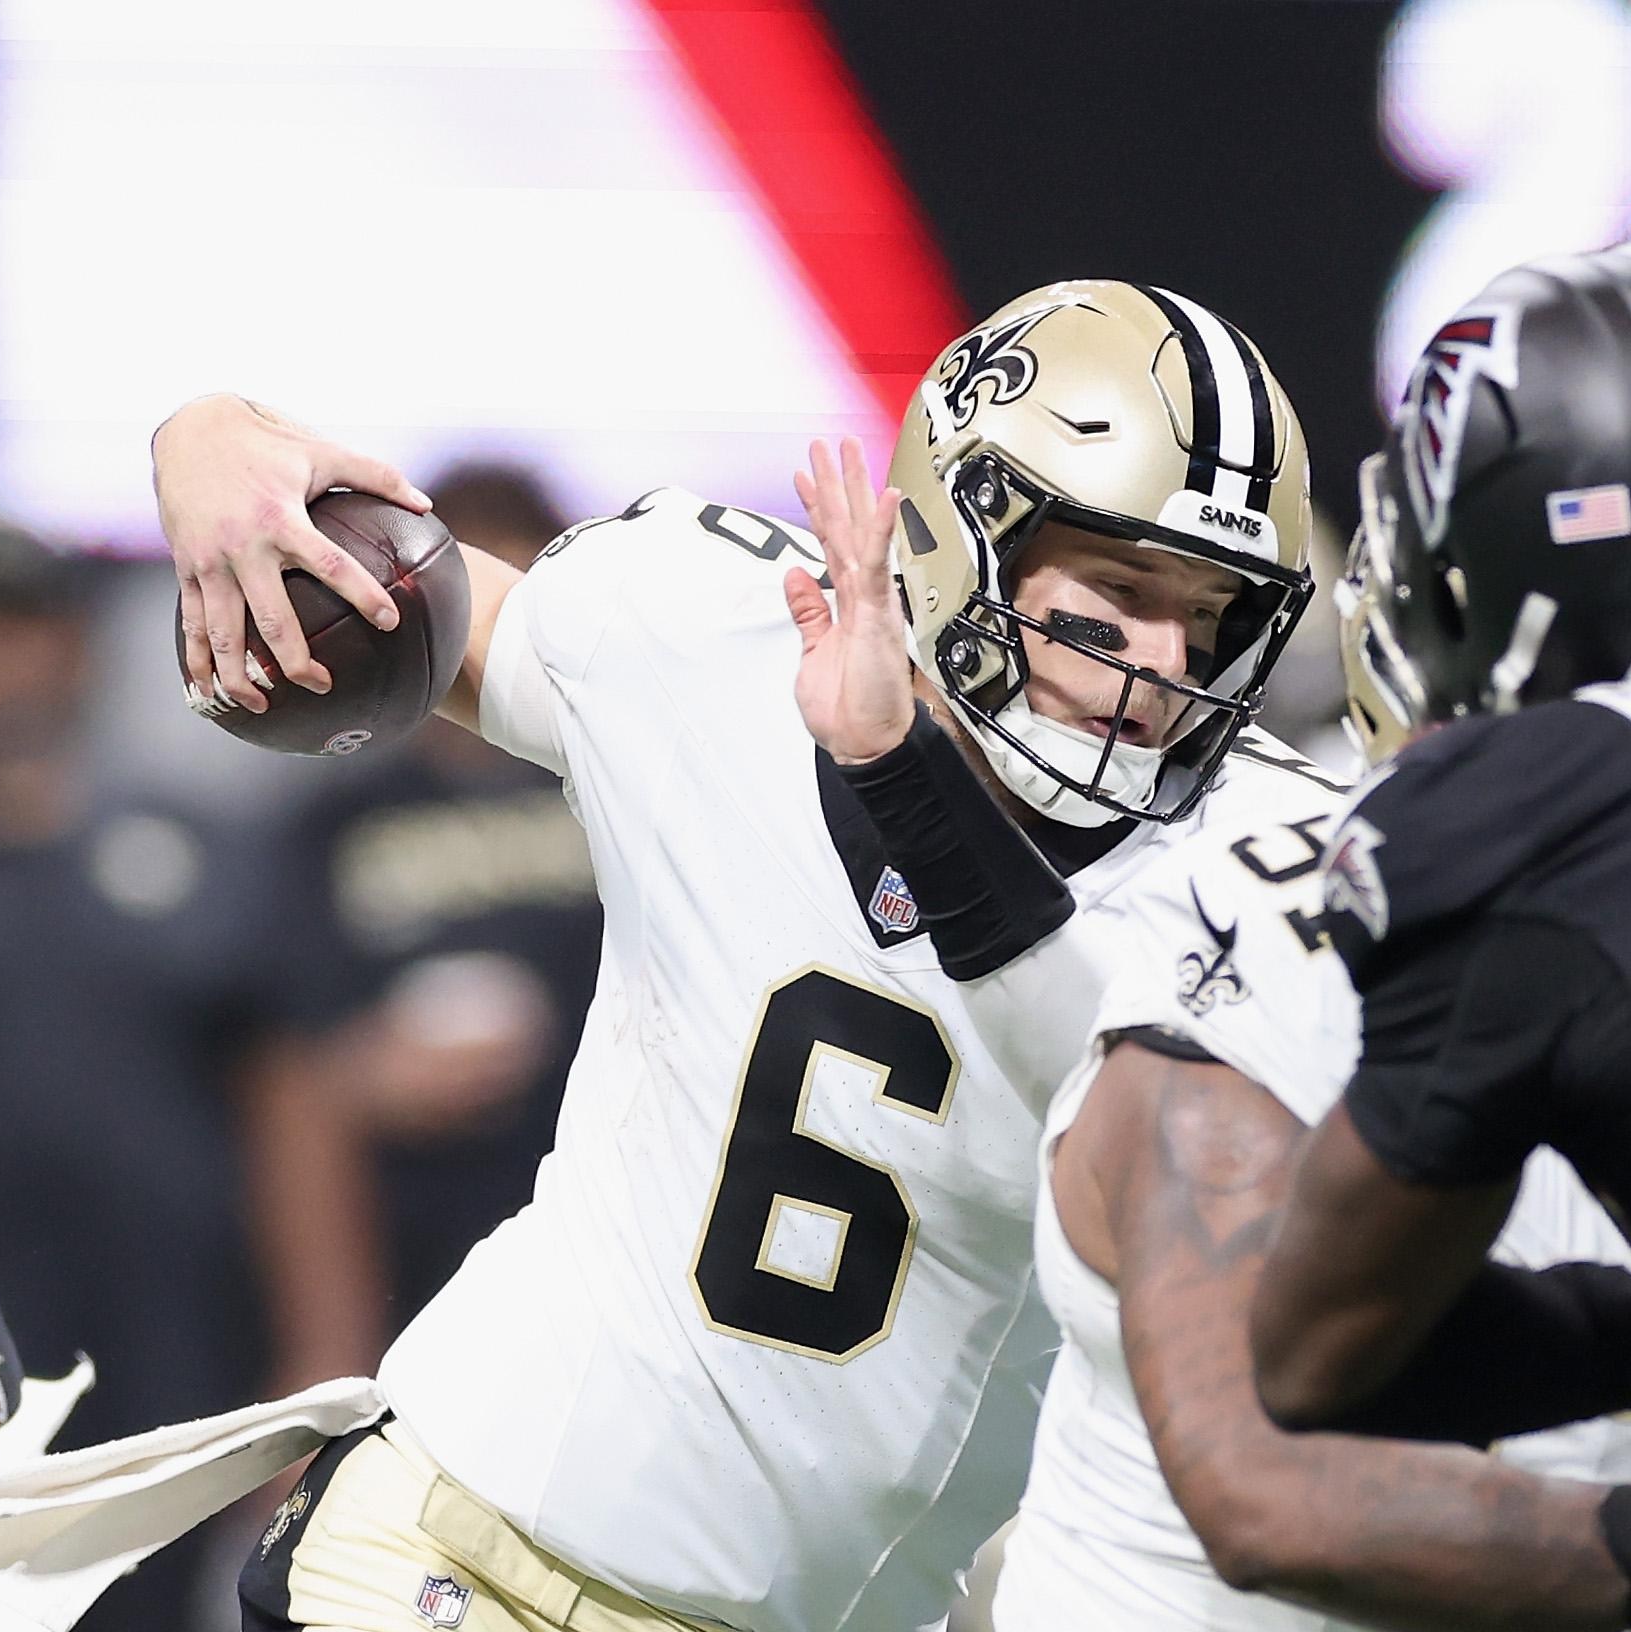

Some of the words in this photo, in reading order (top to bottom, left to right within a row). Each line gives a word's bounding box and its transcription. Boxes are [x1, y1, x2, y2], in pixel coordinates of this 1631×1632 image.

[1199, 505, 1261, 538] SAINTS
[876, 893, 912, 924] NFL
[686, 960, 963, 1368] 6
